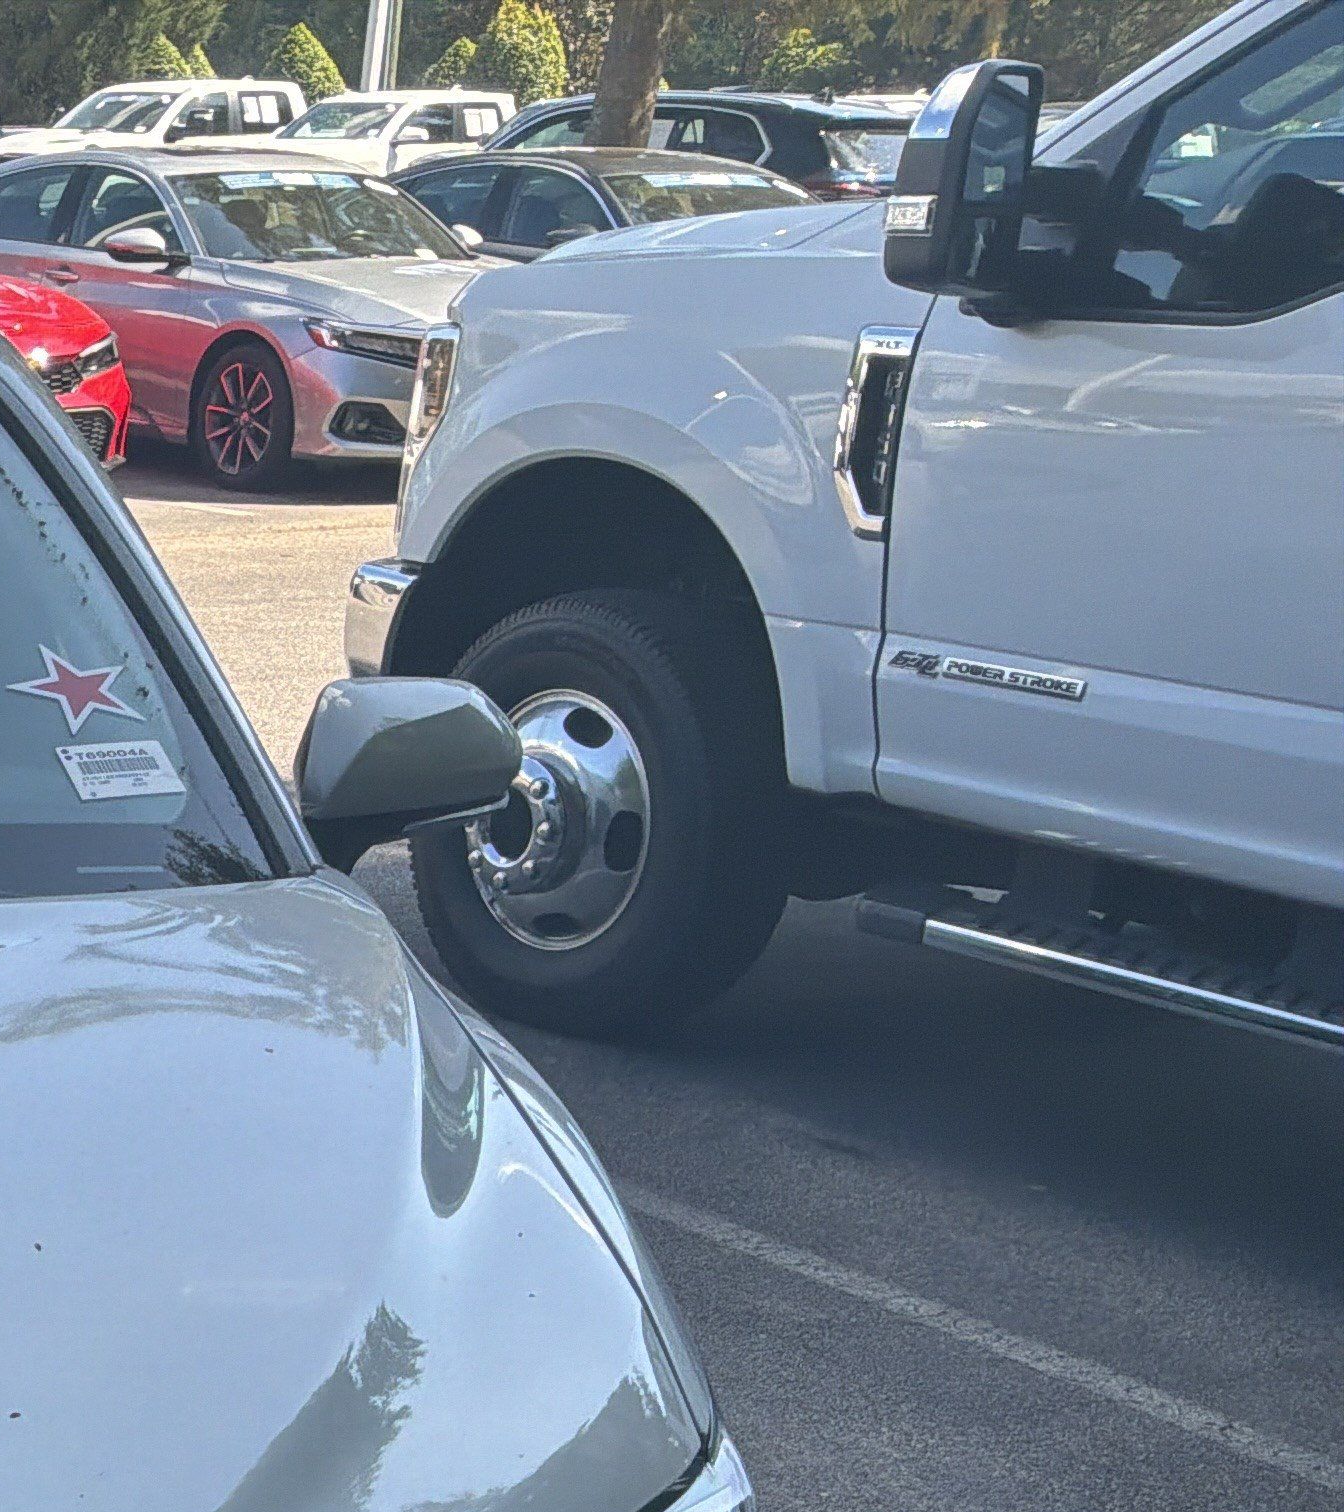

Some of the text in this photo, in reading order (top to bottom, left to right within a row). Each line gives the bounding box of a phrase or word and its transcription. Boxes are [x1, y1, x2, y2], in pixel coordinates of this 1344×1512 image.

[875, 340, 903, 349] XLT
[946, 660, 1005, 681] POWER
[1008, 671, 1080, 694] STROKE
